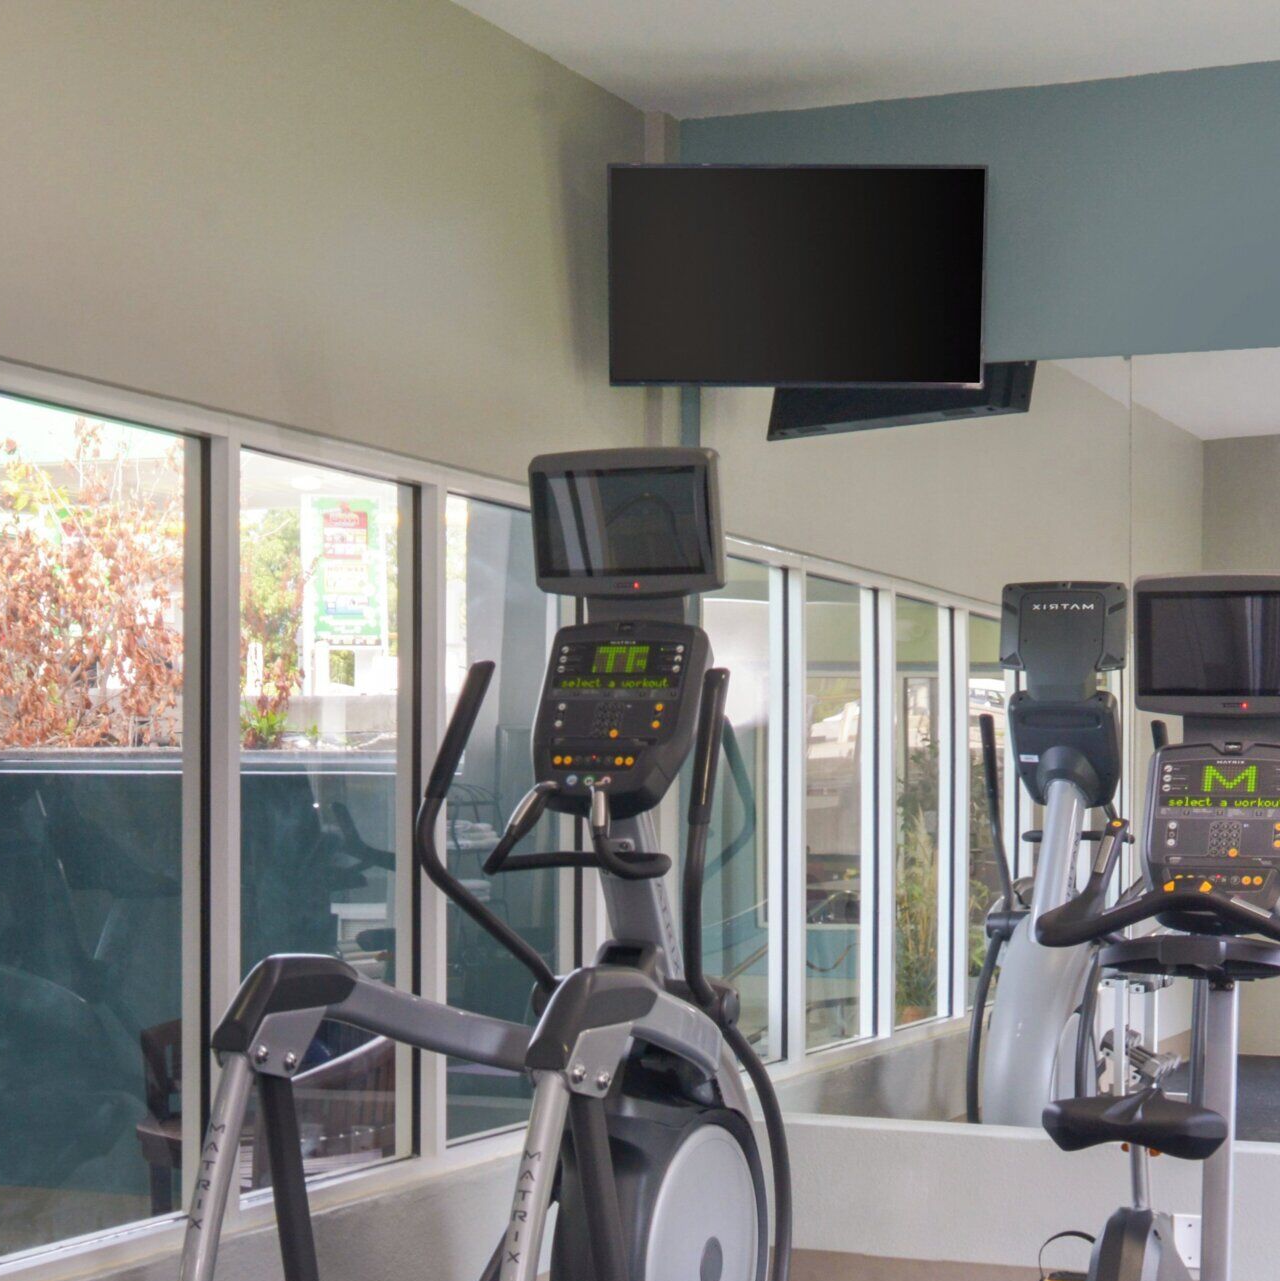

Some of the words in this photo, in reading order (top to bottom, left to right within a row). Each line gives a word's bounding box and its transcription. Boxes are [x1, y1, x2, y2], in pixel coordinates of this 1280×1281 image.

[561, 678, 601, 689] select
[1203, 765, 1257, 793] M
[1168, 796, 1212, 807] select
[190, 1122, 226, 1230] MATRIX
[507, 1150, 542, 1264] MATRIX
